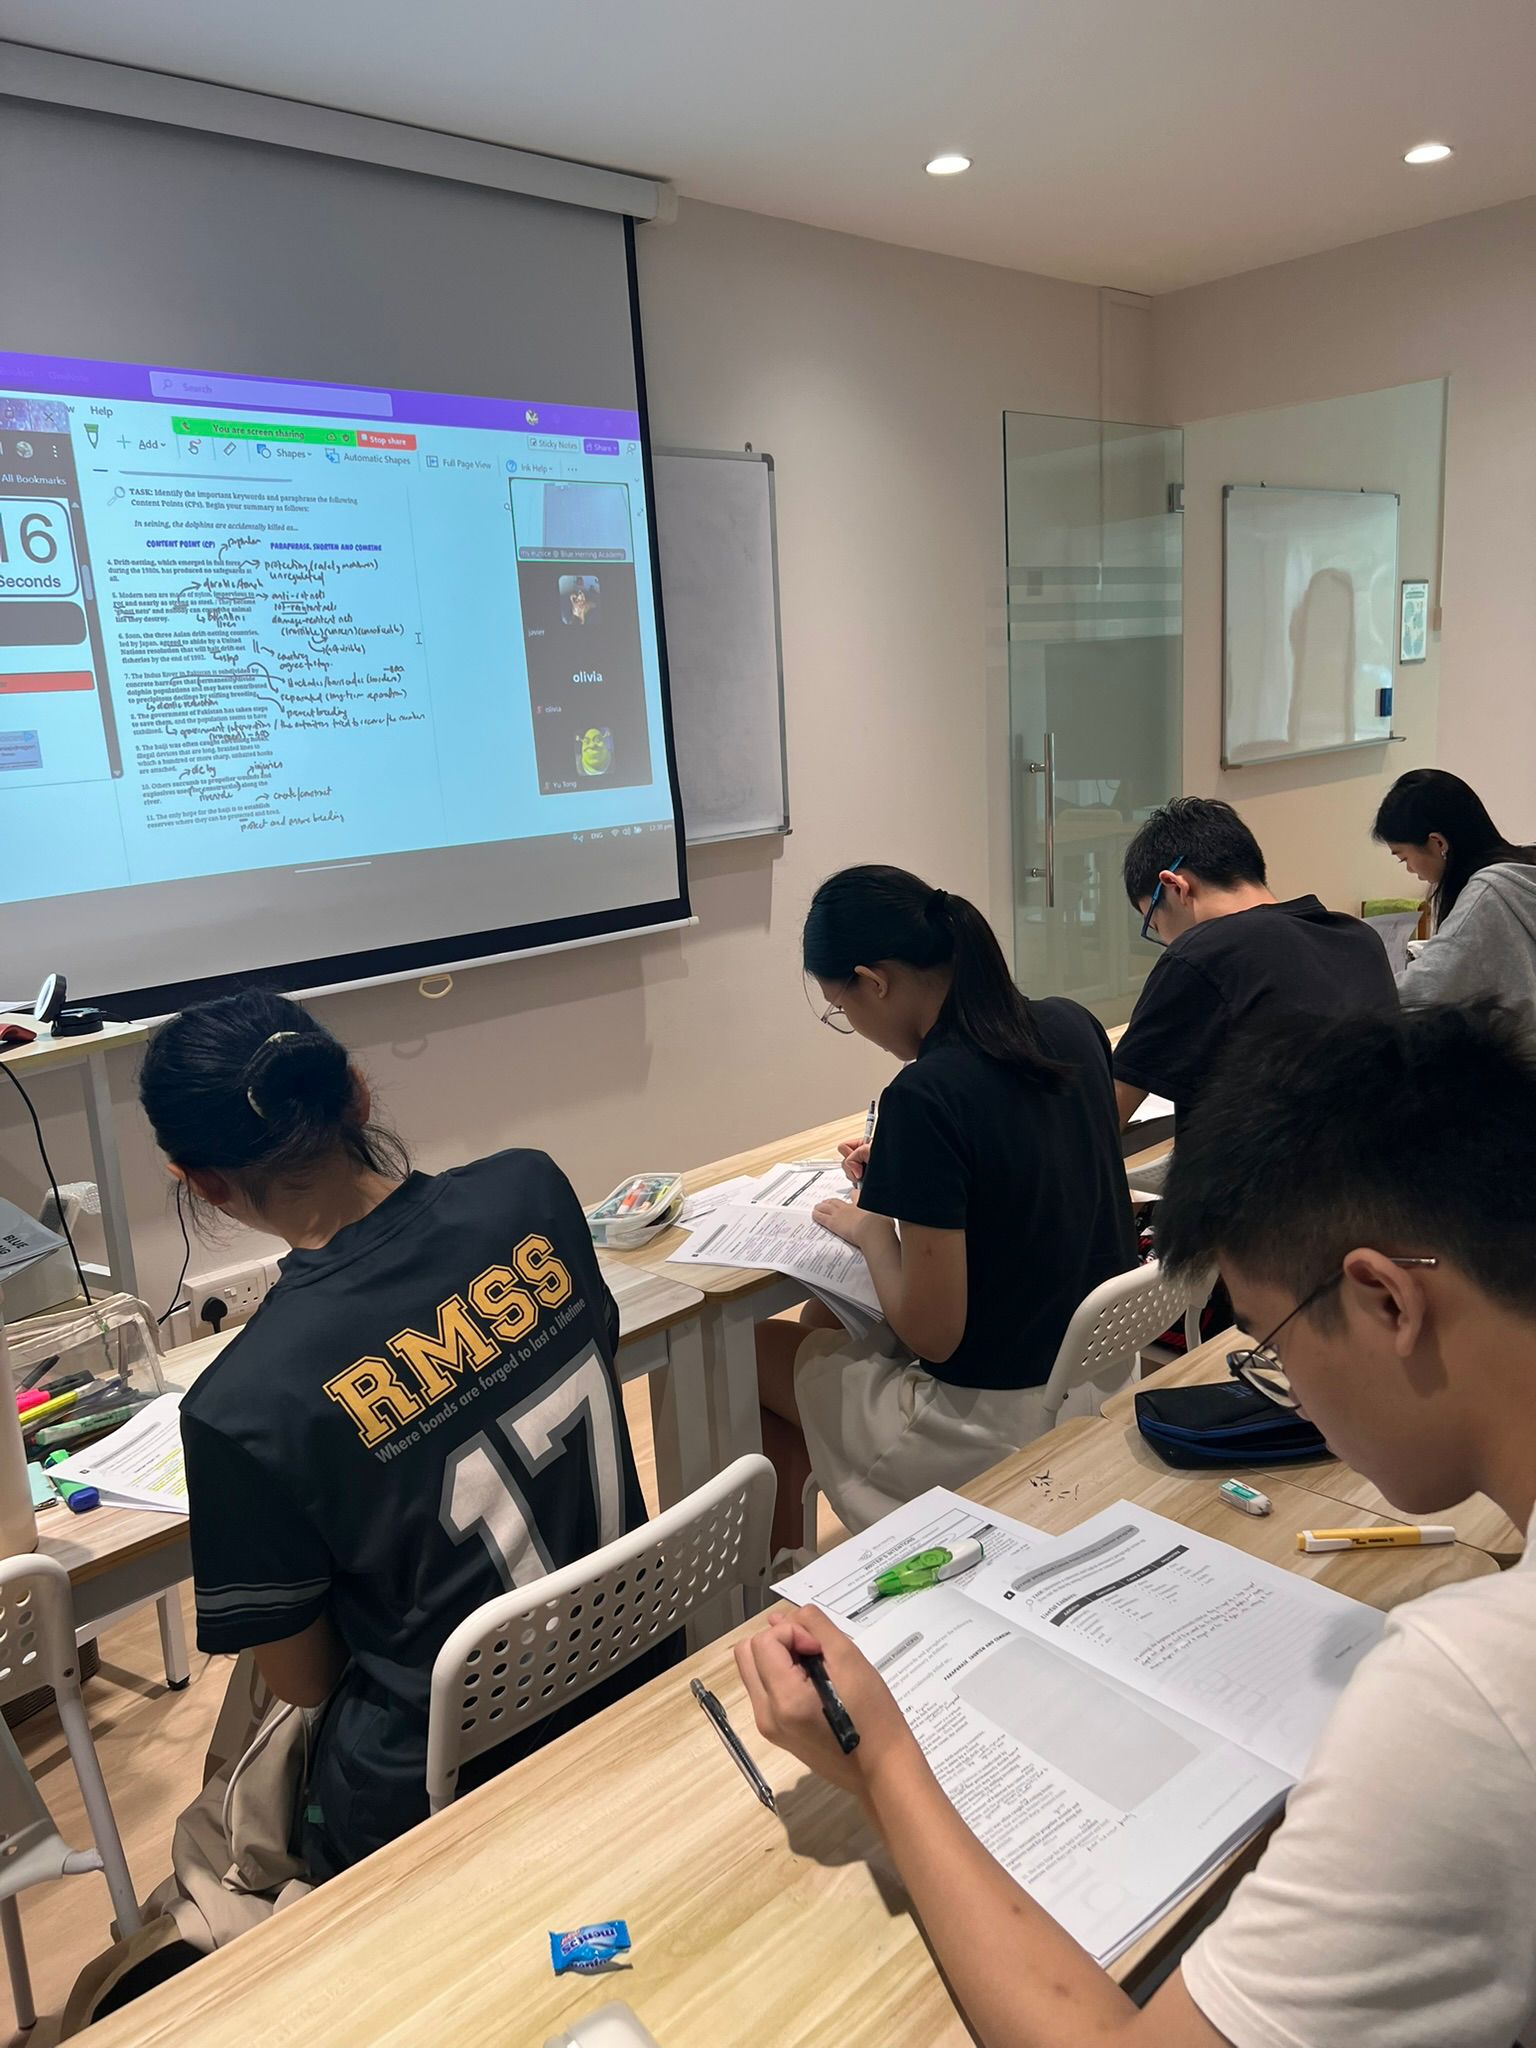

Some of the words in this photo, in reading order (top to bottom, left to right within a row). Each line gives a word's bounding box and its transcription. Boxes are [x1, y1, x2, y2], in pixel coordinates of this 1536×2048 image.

[183, 382, 213, 394] Search
[90, 405, 113, 418] Help
[213, 424, 230, 433] You
[231, 427, 246, 435] are
[247, 427, 275, 437] screen
[276, 428, 305, 440] sharing
[138, 439, 158, 450] Add
[370, 435, 386, 447] Stop
[387, 437, 407, 447] share
[539, 439, 557, 450] Sticky
[558, 440, 578, 450] Notes
[276, 448, 307, 461] Shapes
[343, 452, 383, 464] Automatic
[384, 455, 411, 467] Shapes
[443, 458, 455, 468] Full
[456, 459, 474, 471] Page
[475, 460, 492, 470] View
[521, 464, 531, 472] Ink
[532, 464, 548, 475] Help
[2, 473, 14, 484] All
[16, 474, 67, 486] Bookmarks
[129, 488, 153, 496] TASK:
[155, 489, 183, 498] Identify
[184, 490, 196, 498] the
[198, 490, 231, 500] important
[232, 492, 266, 501] keywords
[280, 495, 317, 503] paraphrase
[329, 497, 359, 506] following
[131, 499, 161, 507] Content
[162, 500, 184, 508] Points
[206, 502, 226, 511] Begin
[226, 503, 243, 511] your
[243, 504, 275, 513] summary
[134, 520, 143, 528] In
[144, 520, 171, 529] seining,
[185, 520, 214, 530] dolphins
[215, 522, 227, 530] are
[227, 523, 266, 532] accidentally
[146, 540, 178, 548] CONTENT
[179, 540, 201, 548] POINT
[202, 541, 216, 549] (CP)
[313, 543, 340, 551] SHORTEN
[355, 544, 383, 552] COMBINE
[598, 551, 625, 561] Academy
[178, 560, 205, 569] emerged
[0, 574, 61, 588] Seconds
[573, 670, 604, 683] olivia
[127, 689, 152, 697] dolphin
[153, 687, 190, 696] populations
[151, 711, 188, 720] government
[197, 708, 223, 716] Pakistan
[591, 831, 603, 840] ENG
[3, 1234, 29, 1249] BLUE
[322, 1233, 572, 1449] RMSS
[375, 1429, 421, 1464] Where
[418, 1403, 458, 1437] bonds
[459, 1386, 480, 1407] are
[479, 1356, 520, 1393] forged
[518, 1344, 532, 1362] to
[531, 1330, 550, 1353] last
[549, 1324, 559, 1338] a
[557, 1297, 587, 1331] lifetime
[439, 1338, 625, 1592] 17
